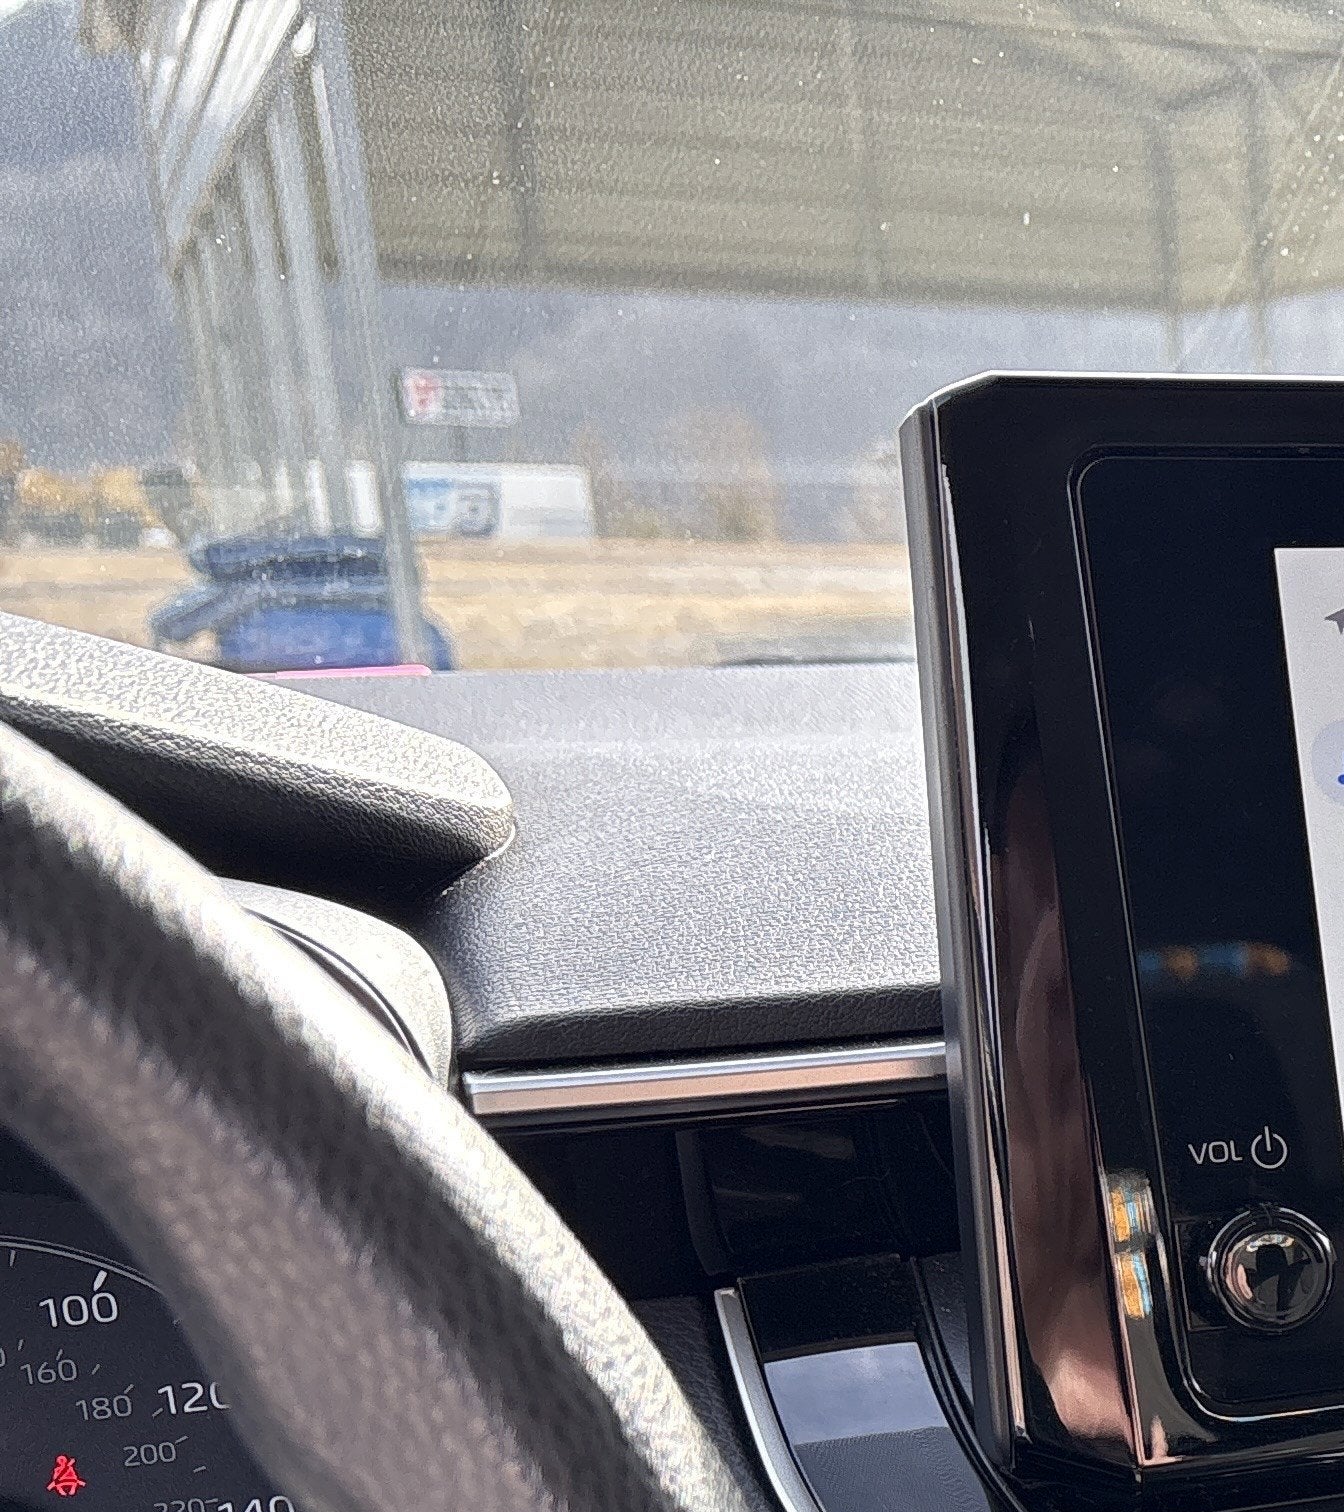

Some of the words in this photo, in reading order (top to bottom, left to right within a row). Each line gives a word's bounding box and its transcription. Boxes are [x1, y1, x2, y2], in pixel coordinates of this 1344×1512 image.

[1188, 1140, 1242, 1164] VOL
[39, 1292, 118, 1328] 100
[20, 1360, 76, 1385] 160
[76, 1395, 131, 1420] 180
[123, 1442, 176, 1466] 200
